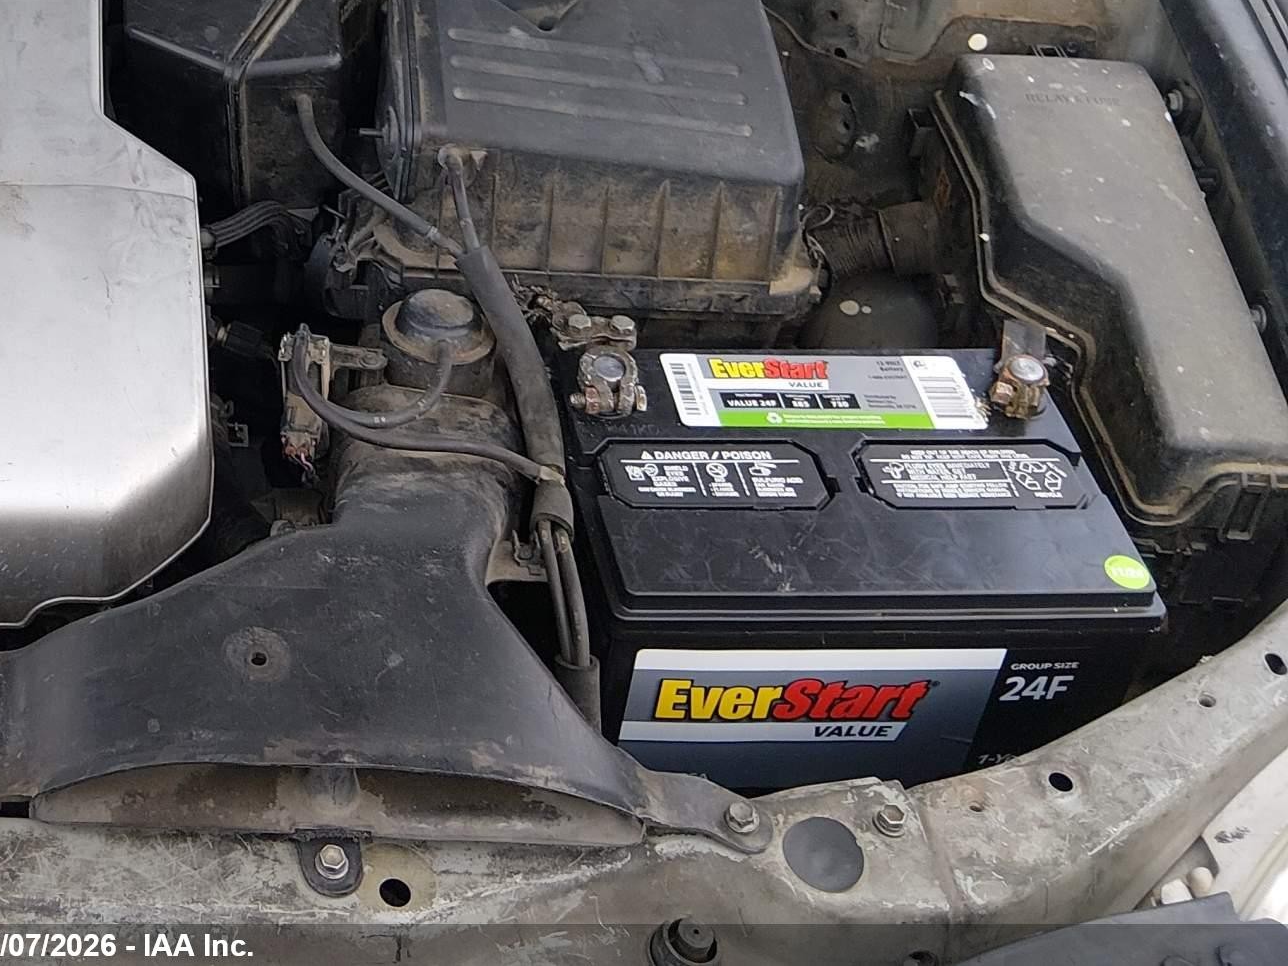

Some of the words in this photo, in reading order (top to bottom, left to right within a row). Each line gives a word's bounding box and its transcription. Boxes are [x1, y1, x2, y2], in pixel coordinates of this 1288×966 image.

[708, 357, 828, 380] EverStart
[726, 399, 758, 407] VALUE
[653, 450, 709, 460] DANGER
[722, 451, 772, 460] POISON
[1010, 663, 1052, 671] GROUP
[1054, 662, 1080, 670] SIZE
[999, 675, 1074, 701] 24F
[654, 678, 931, 721] EverStart
[813, 724, 893, 738] VALUE
